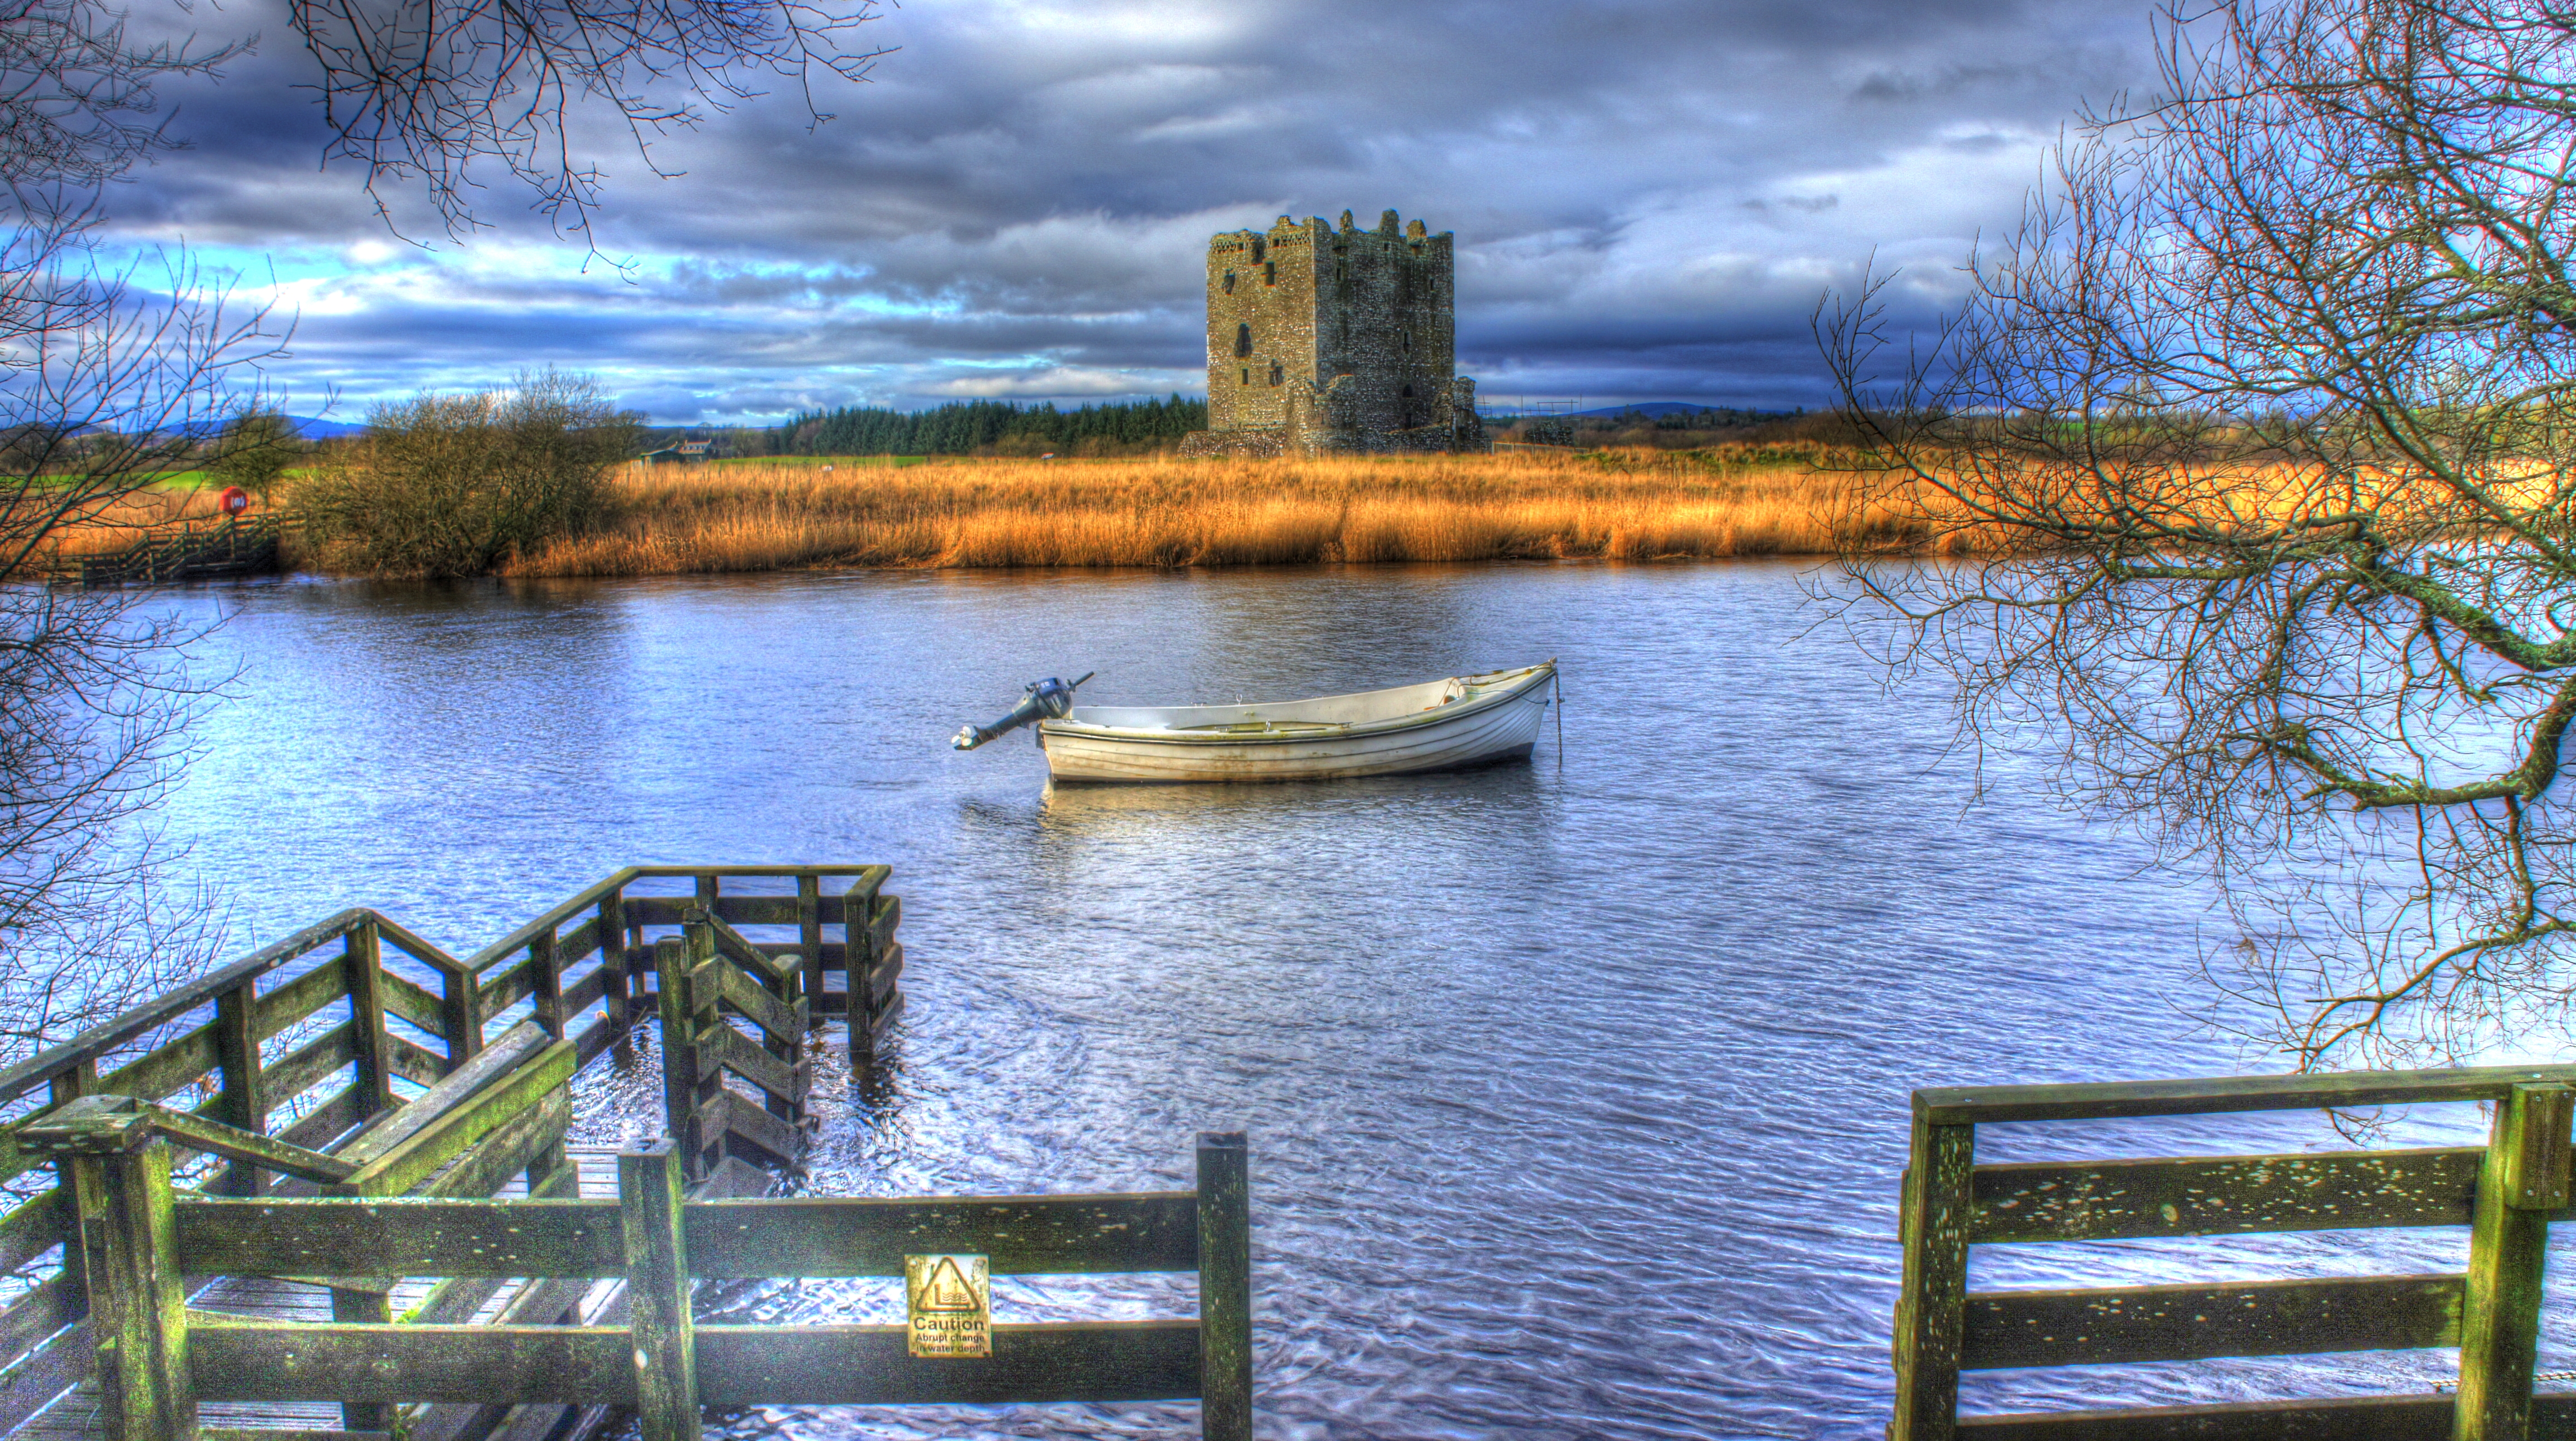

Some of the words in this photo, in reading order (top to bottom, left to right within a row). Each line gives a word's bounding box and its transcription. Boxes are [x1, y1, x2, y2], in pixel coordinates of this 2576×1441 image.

[914, 1317, 984, 1330] Caution
[917, 1333, 947, 1343] Abrupt
[950, 1333, 984, 1343] change
[958, 1344, 985, 1353] depth
